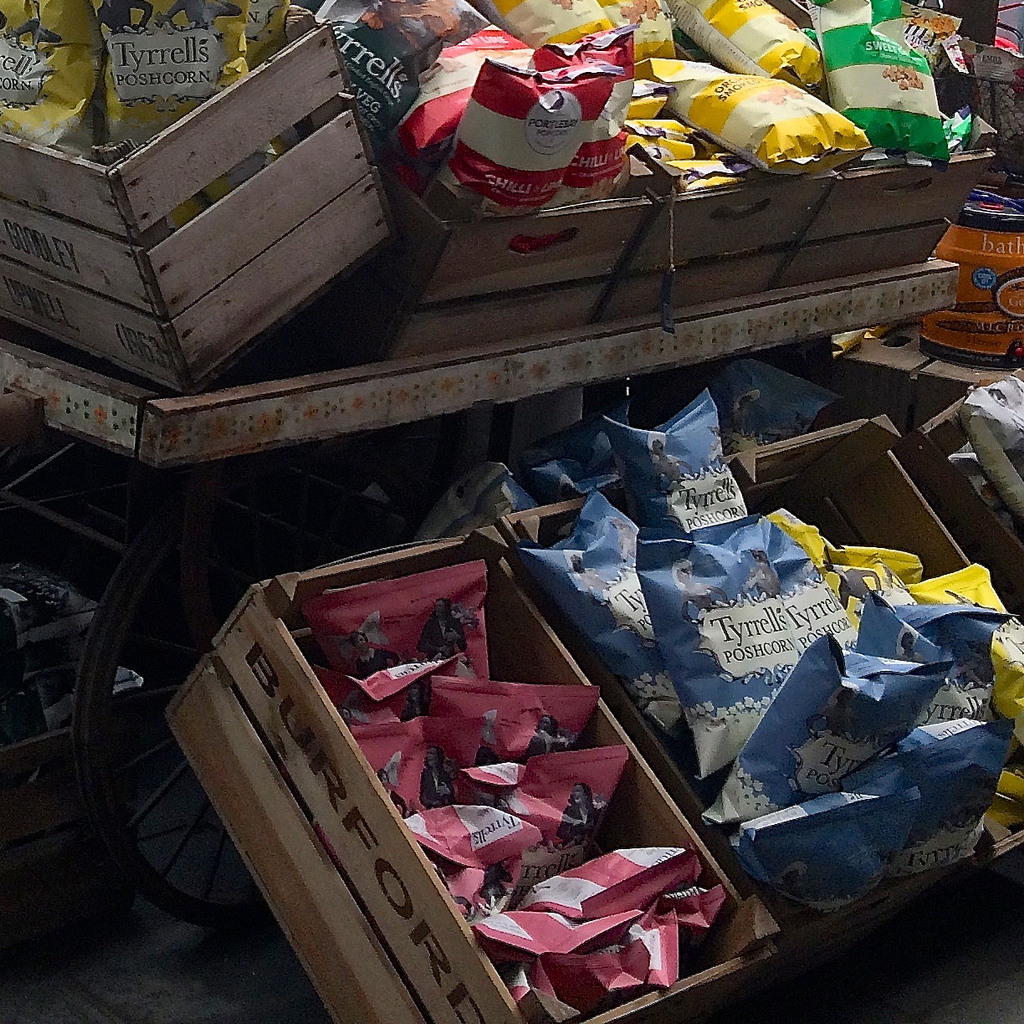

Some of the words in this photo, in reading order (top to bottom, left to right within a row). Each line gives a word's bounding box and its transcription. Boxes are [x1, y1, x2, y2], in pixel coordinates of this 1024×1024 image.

[115, 70, 211, 87] POSHCORN
[684, 504, 747, 532] POSHCORN
[724, 637, 796, 664] POSHCORN
